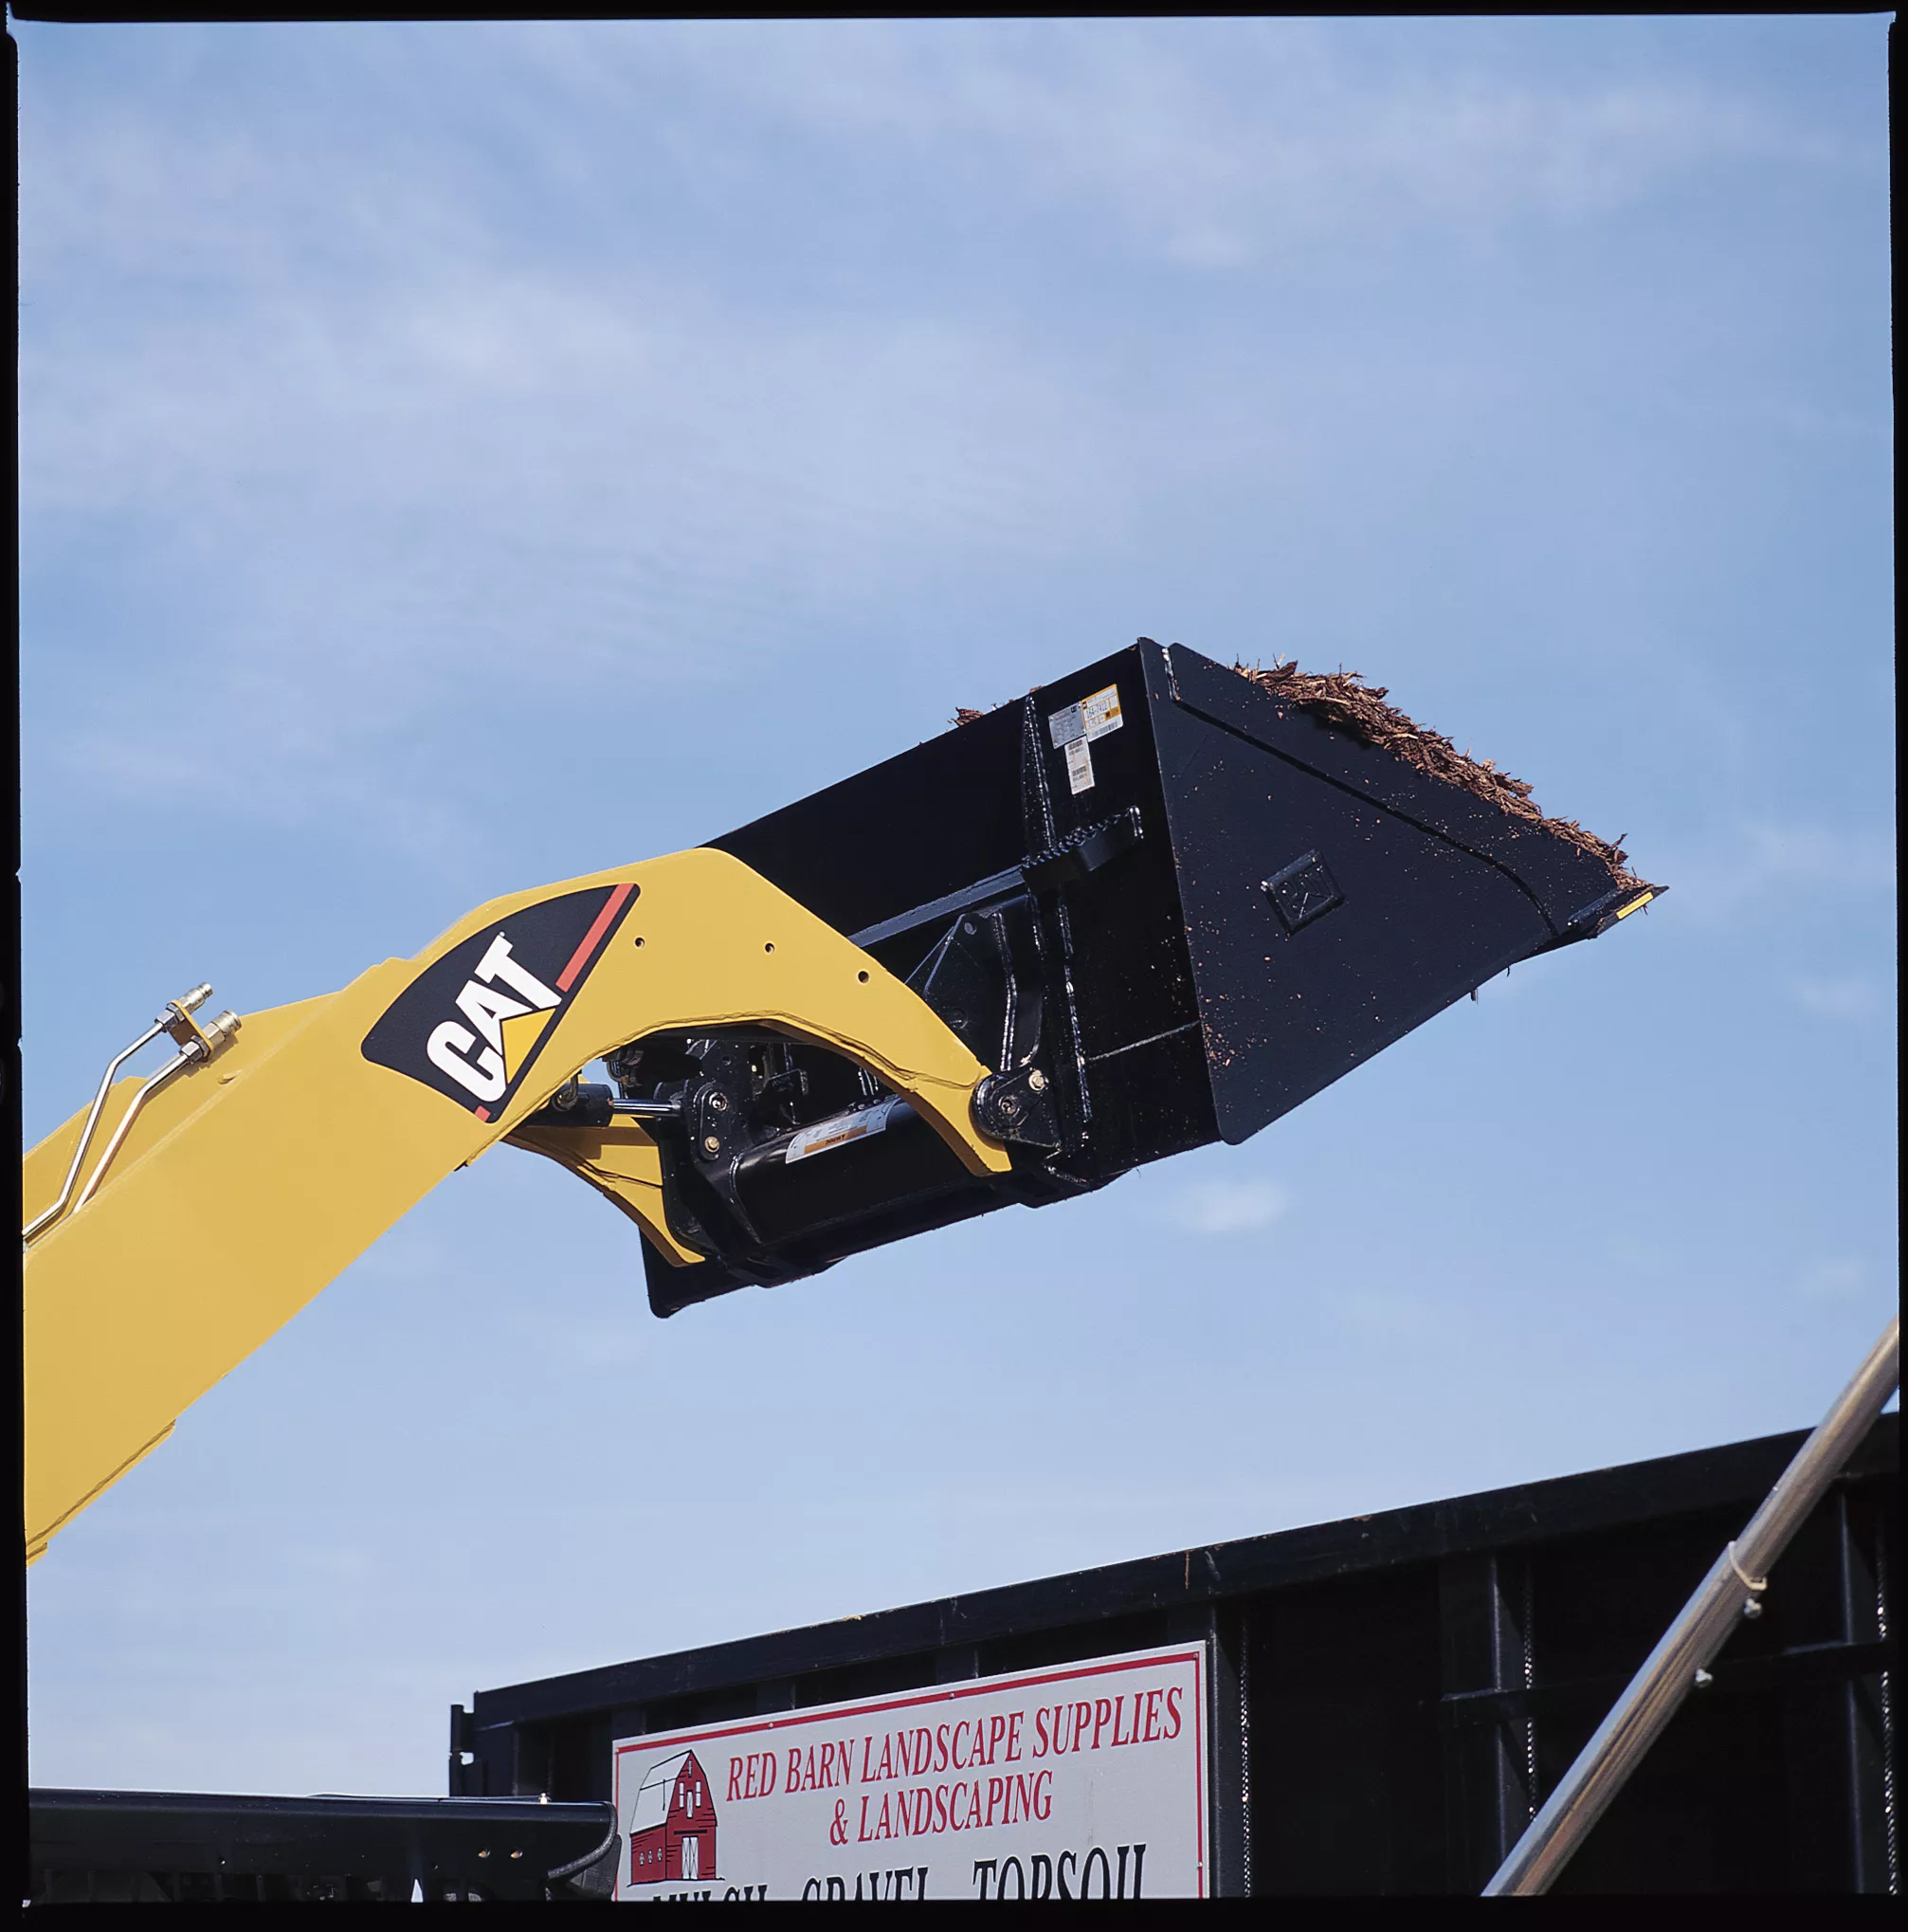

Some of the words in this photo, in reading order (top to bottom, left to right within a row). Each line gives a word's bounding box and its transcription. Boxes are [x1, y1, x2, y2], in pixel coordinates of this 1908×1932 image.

[427, 934, 562, 1103] CAT
[726, 1752, 777, 1801] RED
[785, 1739, 855, 1794] BARN
[861, 1711, 1025, 1783] LANDSCAPE
[1032, 1686, 1183, 1759] SUPPLIES
[829, 1798, 848, 1846] &
[857, 1769, 1052, 1843] LANDSCAPING
